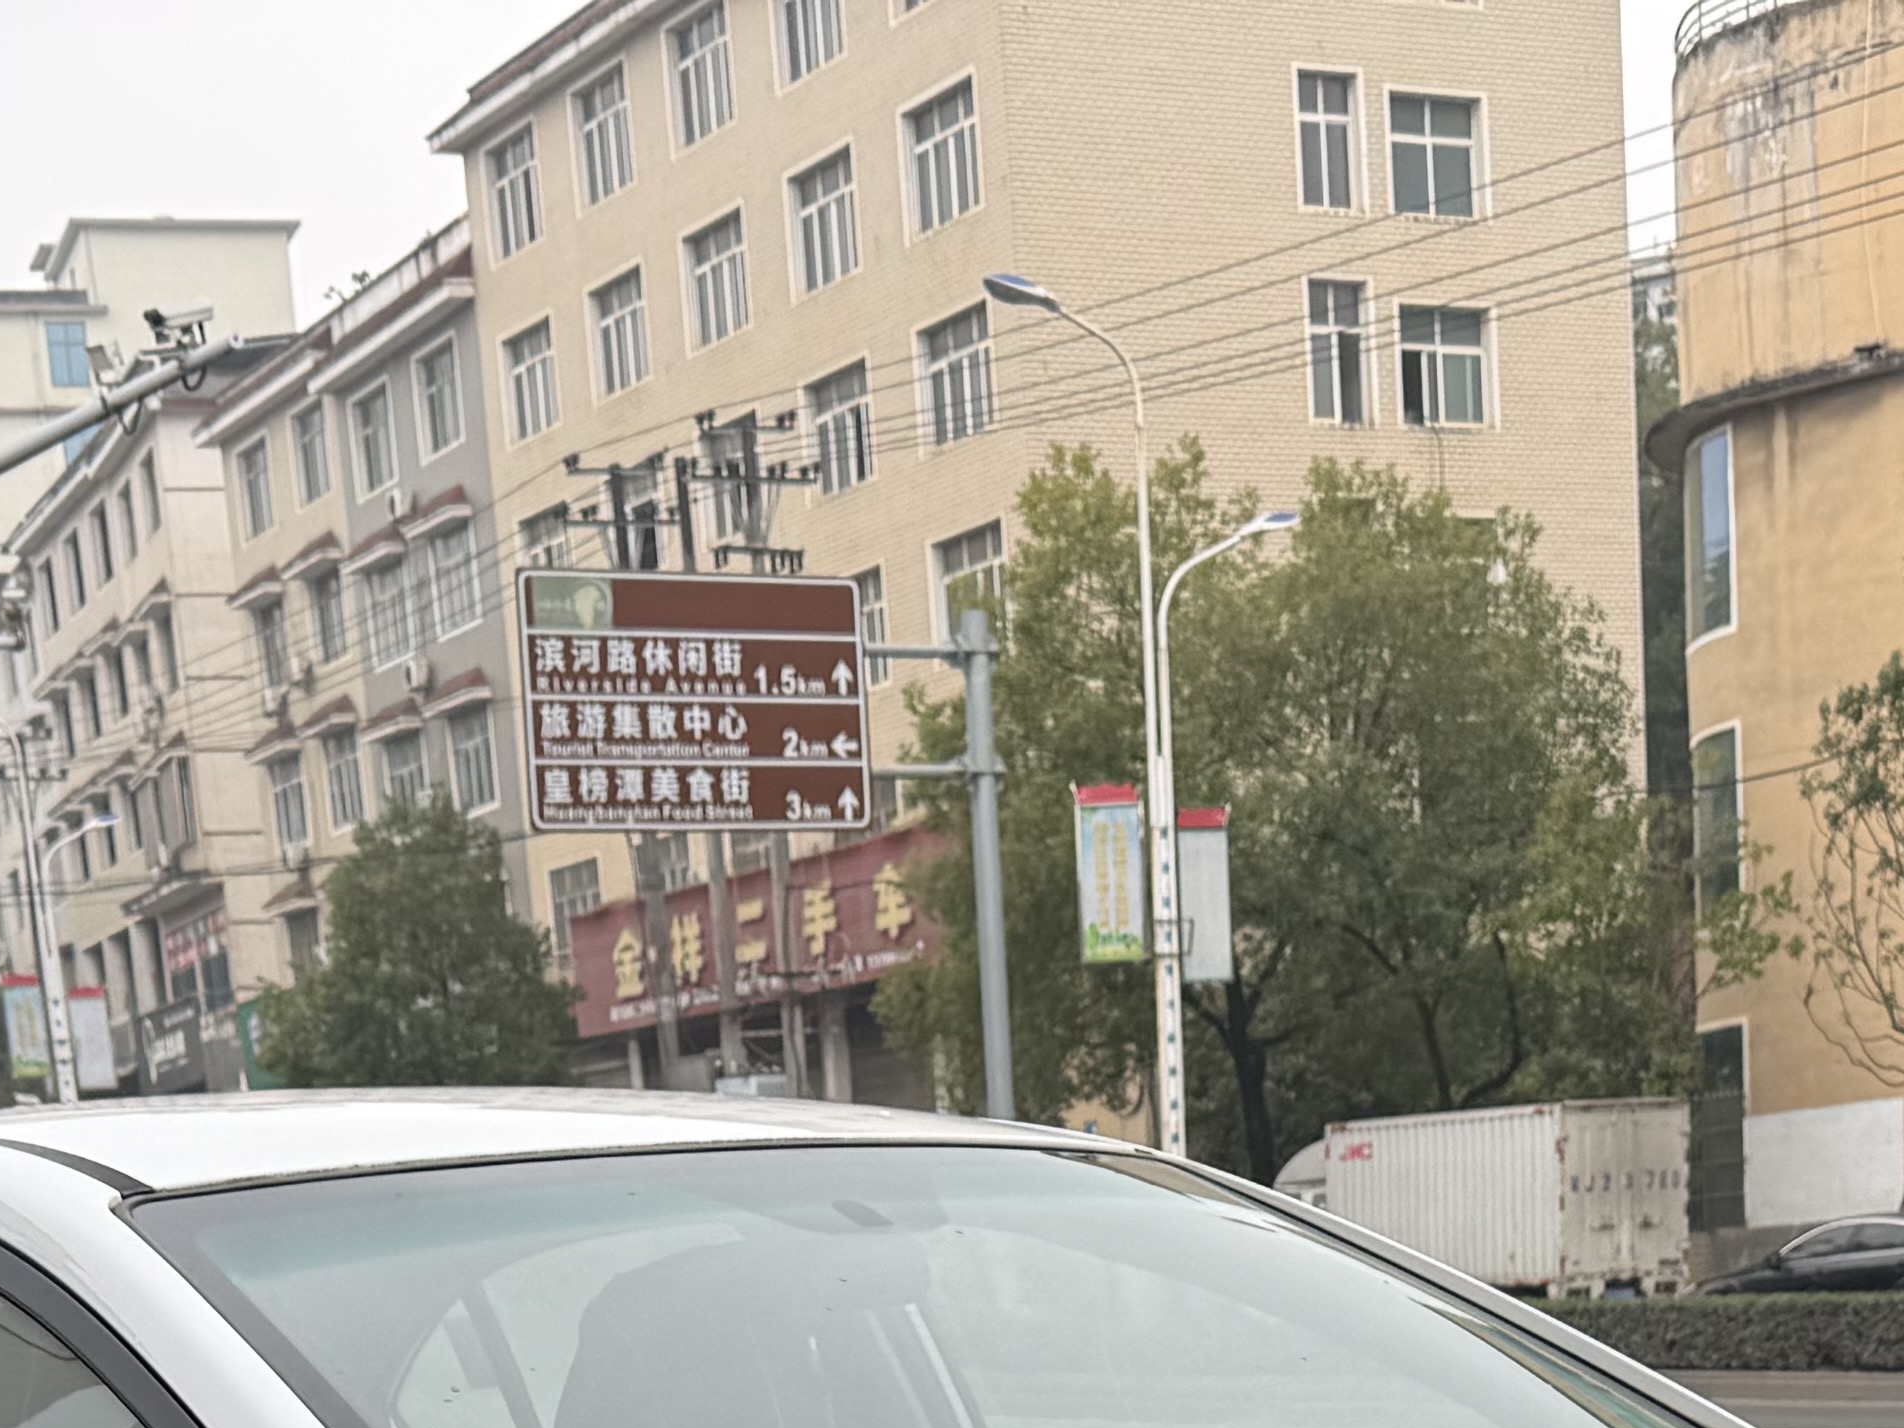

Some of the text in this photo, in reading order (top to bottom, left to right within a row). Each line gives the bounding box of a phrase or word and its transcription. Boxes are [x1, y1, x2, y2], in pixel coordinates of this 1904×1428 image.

[535, 637, 743, 678] 滨河路休闲街
[536, 677, 748, 696] Riverside Avenue
[753, 663, 827, 696] 1.5km
[539, 702, 748, 741] 旅游集散中心
[782, 727, 829, 759] 2km
[784, 788, 832, 821] 3km
